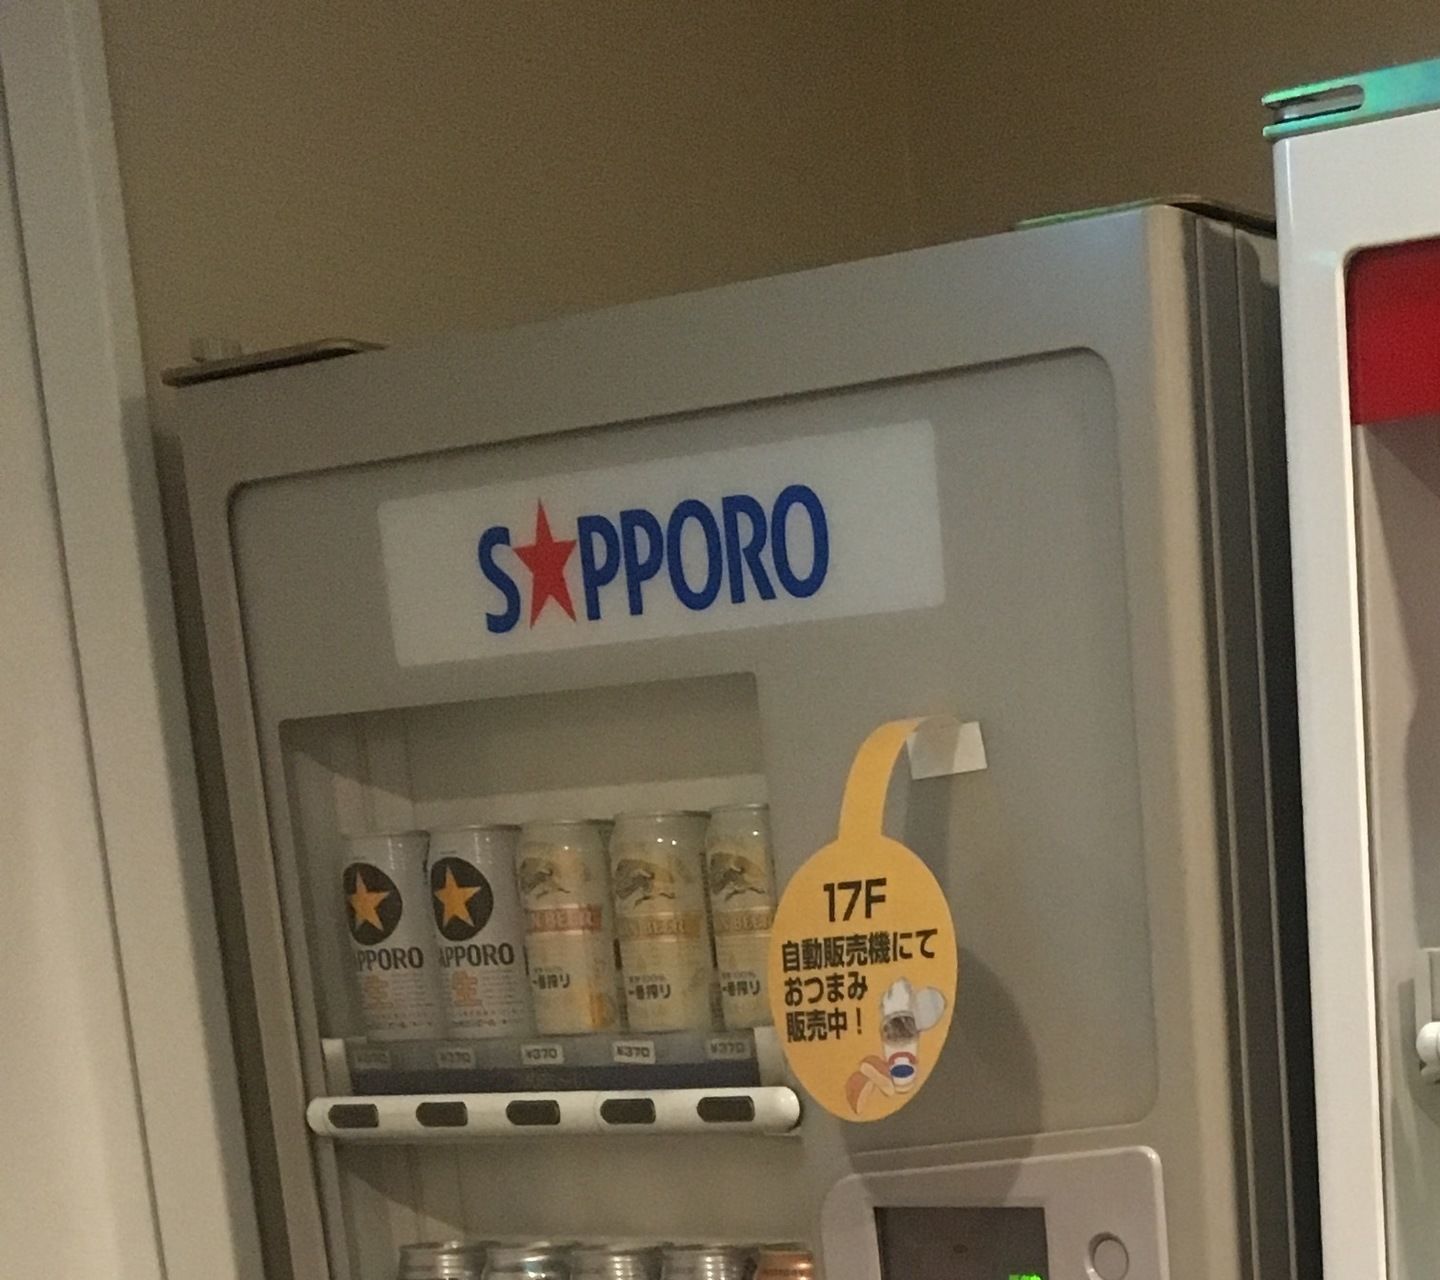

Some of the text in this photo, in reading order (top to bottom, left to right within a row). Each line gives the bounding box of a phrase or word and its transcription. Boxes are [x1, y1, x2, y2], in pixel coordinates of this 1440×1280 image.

[823, 877, 888, 923] 17F
[781, 928, 939, 974] 自動販売機にて
[784, 971, 869, 1007] おつまみ
